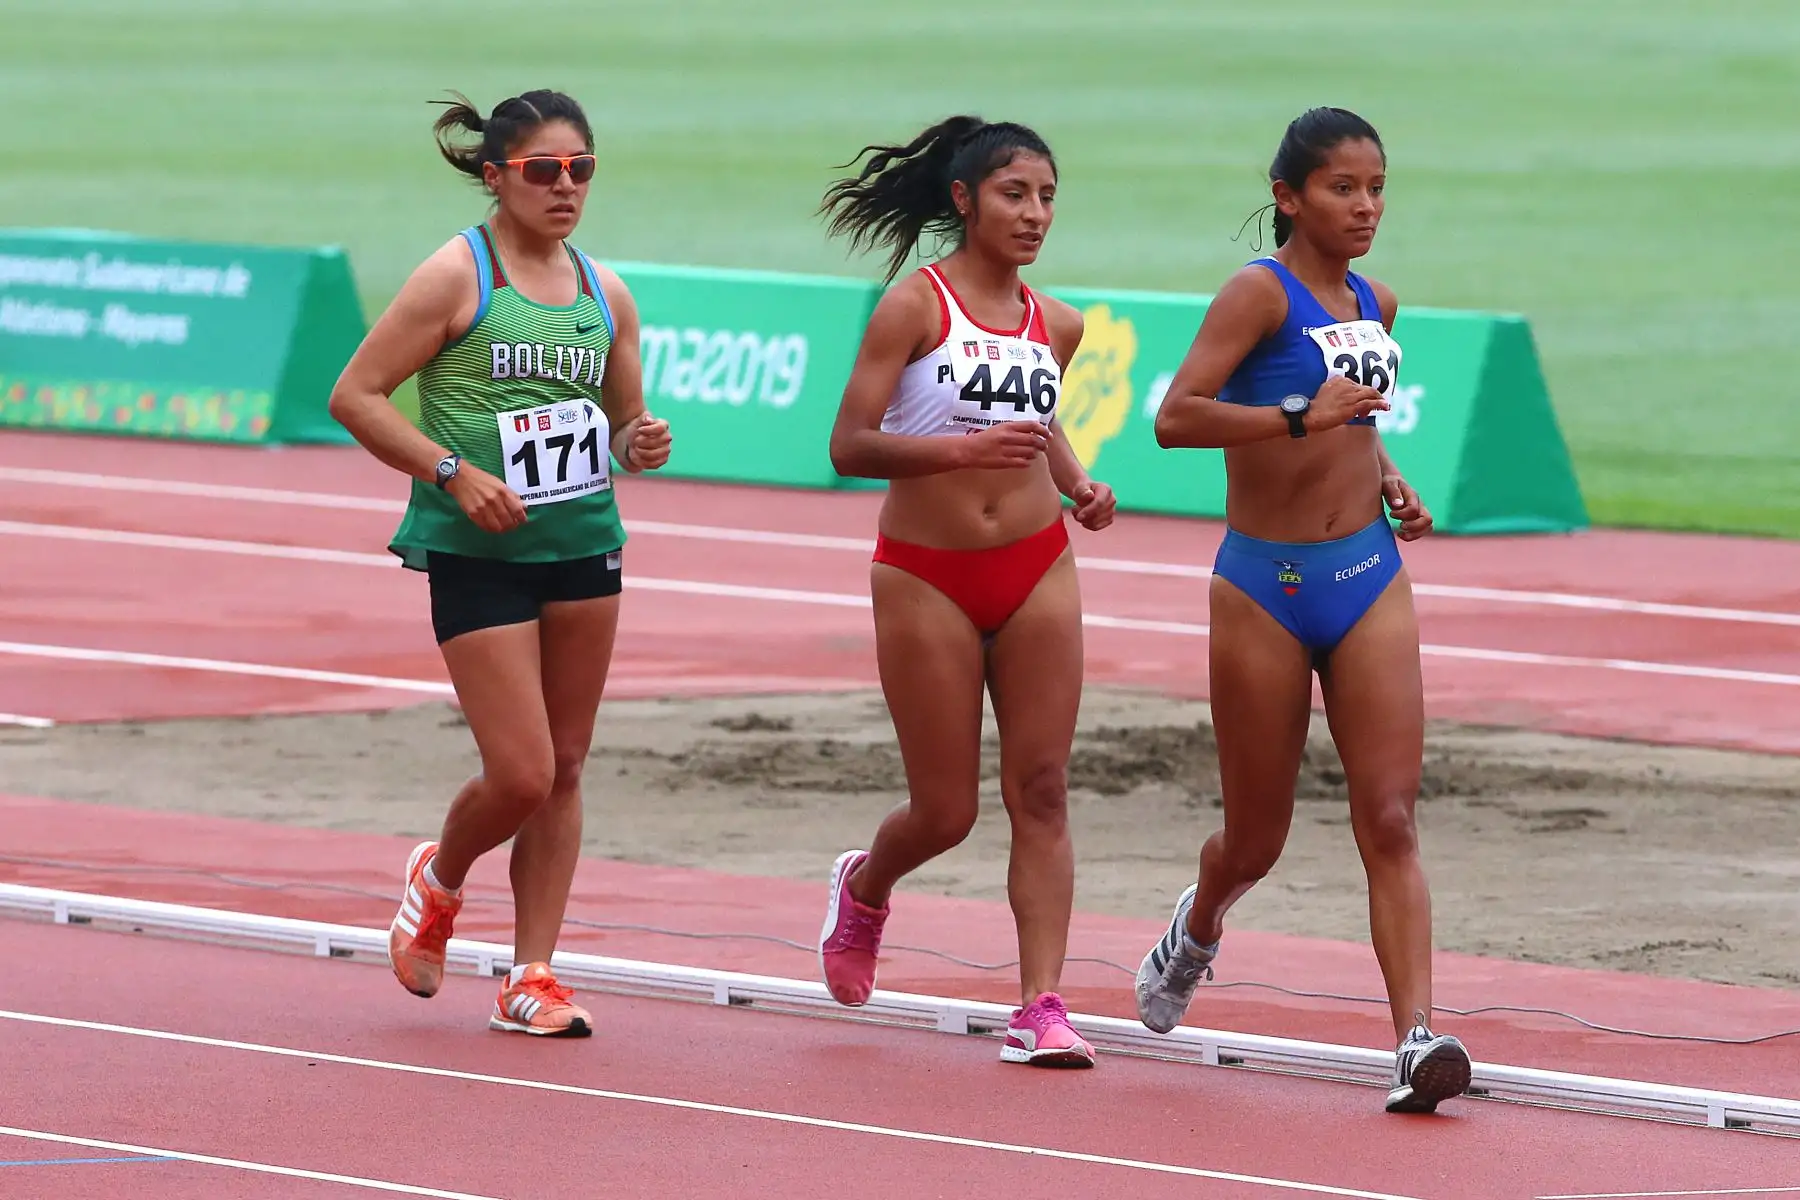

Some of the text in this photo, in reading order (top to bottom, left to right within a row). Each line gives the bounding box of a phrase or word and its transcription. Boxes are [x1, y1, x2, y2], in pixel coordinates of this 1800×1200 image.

[640, 326, 808, 408] ma2019
[959, 364, 1056, 415] 446
[953, 415, 991, 426] CAMPEONATO
[512, 427, 599, 488] 171
[520, 490, 549, 500] MPEONATO
[1335, 553, 1381, 582] ECUADOR
